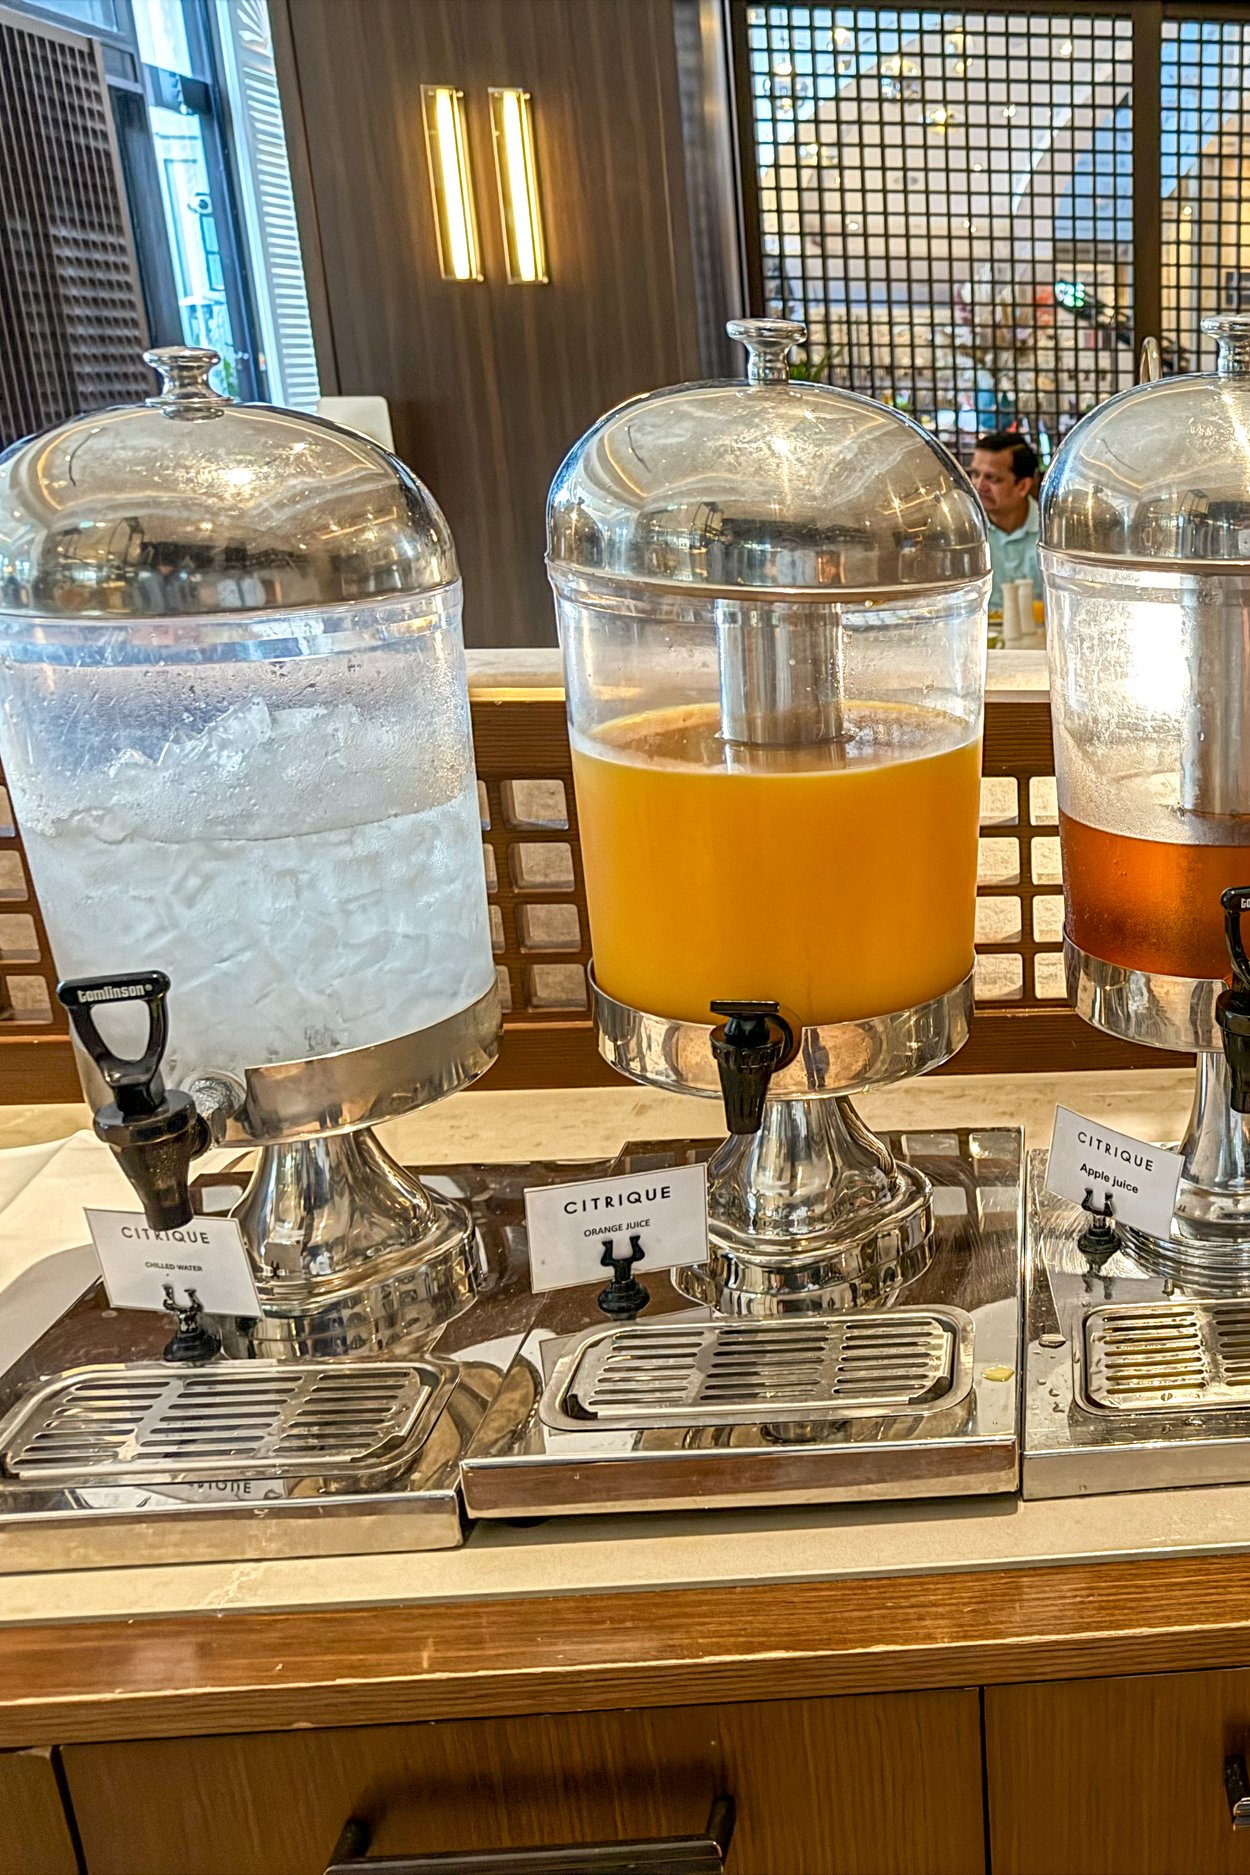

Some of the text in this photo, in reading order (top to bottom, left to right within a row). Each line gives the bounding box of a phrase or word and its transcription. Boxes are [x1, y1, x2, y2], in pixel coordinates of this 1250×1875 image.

[77, 984, 145, 1003] tomlinson
[1077, 1131, 1154, 1172] CITRIQUE
[1079, 1163, 1139, 1194] Apple juice
[563, 1185, 672, 1215] CITRIQUE
[583, 1218, 651, 1238] ORANGE JUICE
[145, 1261, 203, 1272] CHILLED WATER
